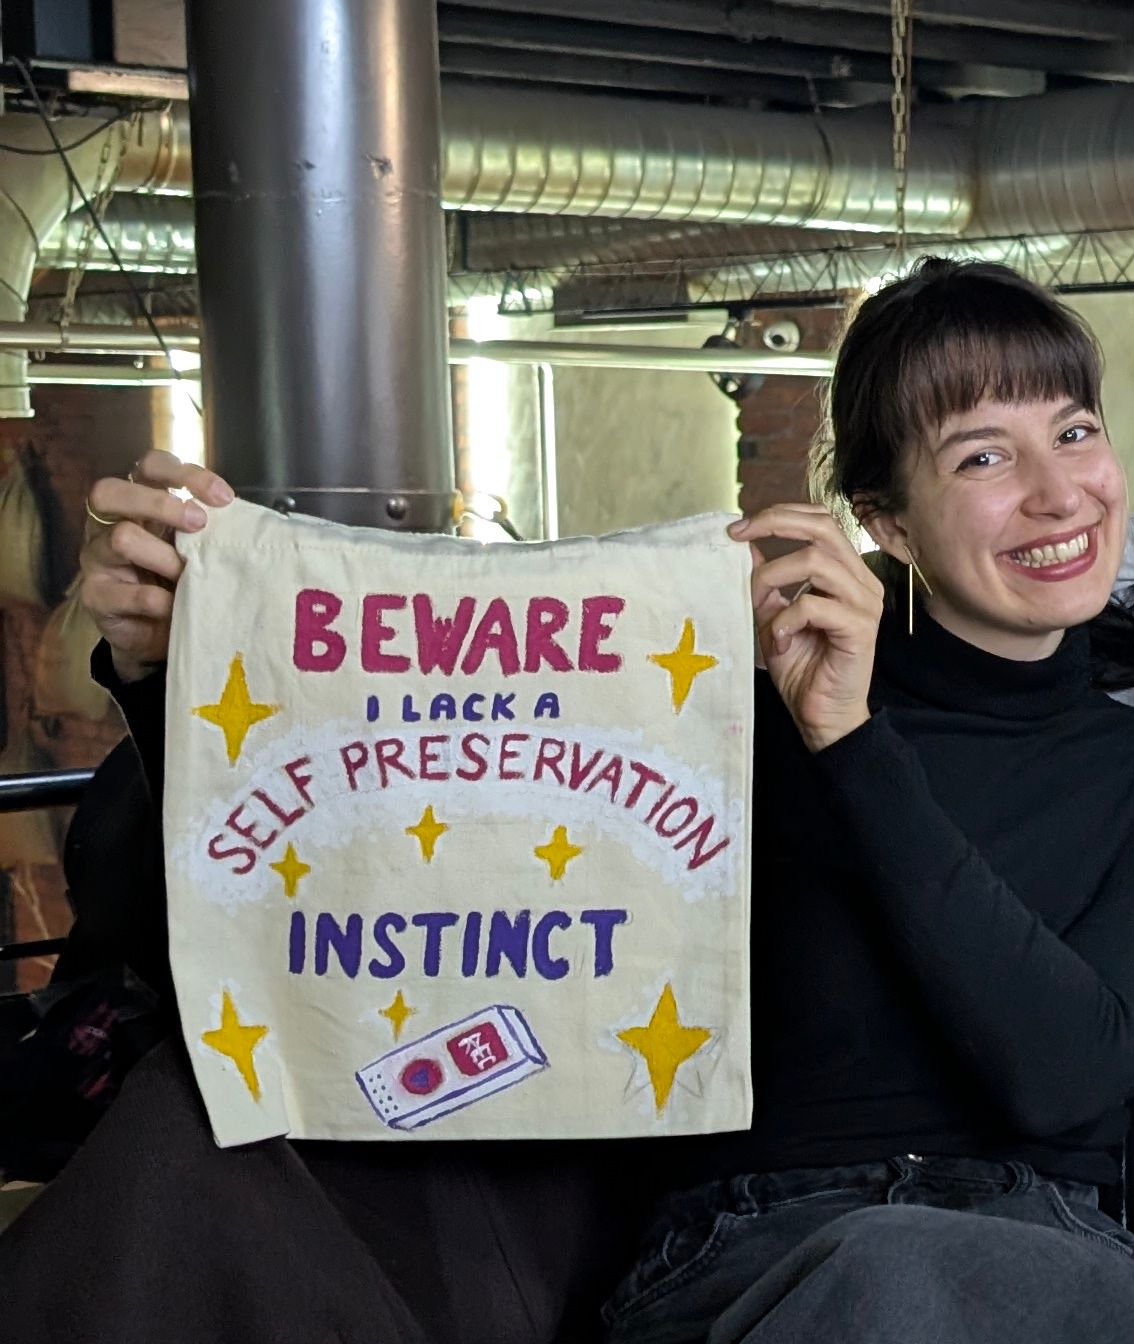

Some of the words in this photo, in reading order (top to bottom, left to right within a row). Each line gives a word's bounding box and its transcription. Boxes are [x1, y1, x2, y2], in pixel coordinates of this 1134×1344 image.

[292, 588, 626, 677] BEWARE
[366, 696, 379, 722] I
[401, 693, 516, 723] LACK
[534, 692, 561, 720] A
[207, 756, 316, 876] SELF
[340, 733, 732, 872] PRESERVATION
[288, 909, 629, 982] INSTINCT
[457, 1031, 498, 1071] REC
